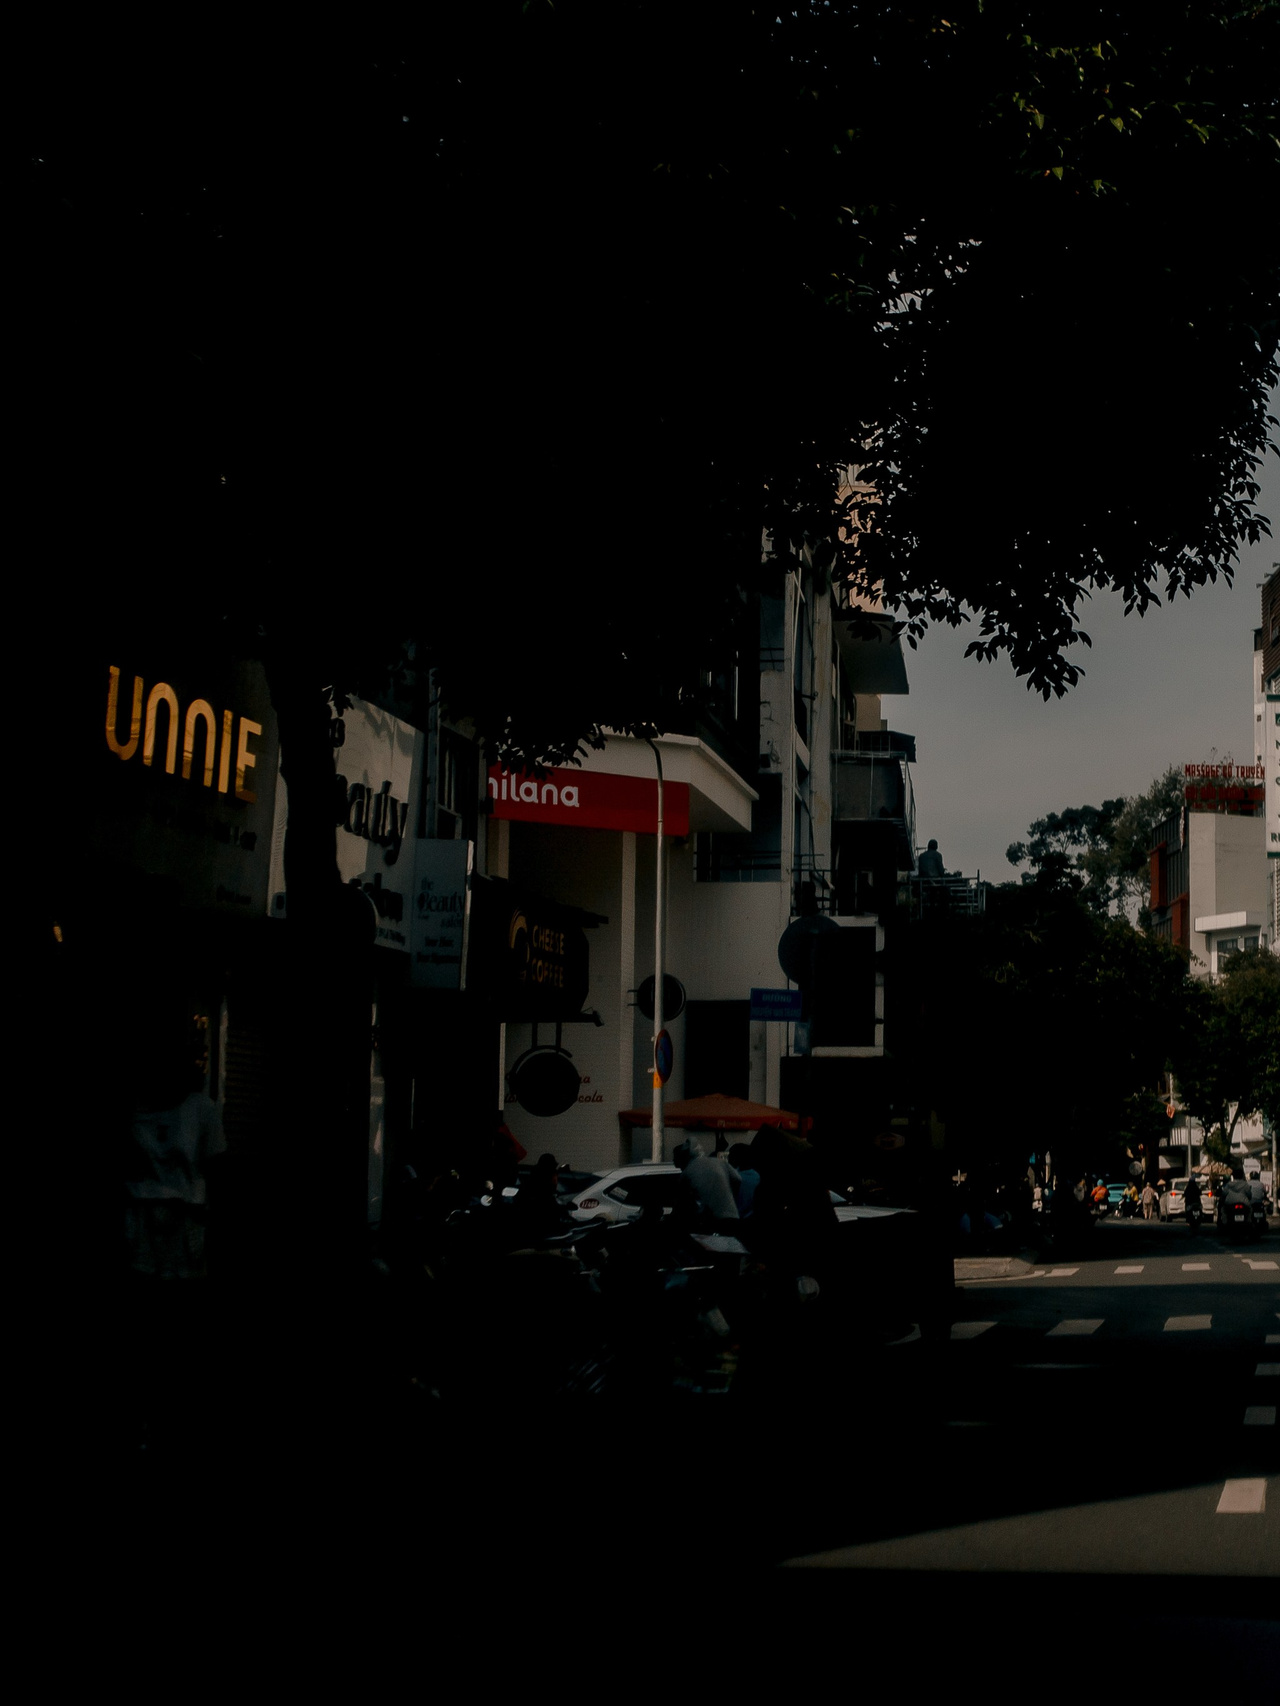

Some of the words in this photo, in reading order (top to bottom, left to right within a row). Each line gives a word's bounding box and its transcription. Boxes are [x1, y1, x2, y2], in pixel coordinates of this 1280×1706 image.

[1184, 763, 1220, 778] MASSAGE
[532, 924, 566, 956] CHEESE
[531, 957, 565, 989] COFFEE
